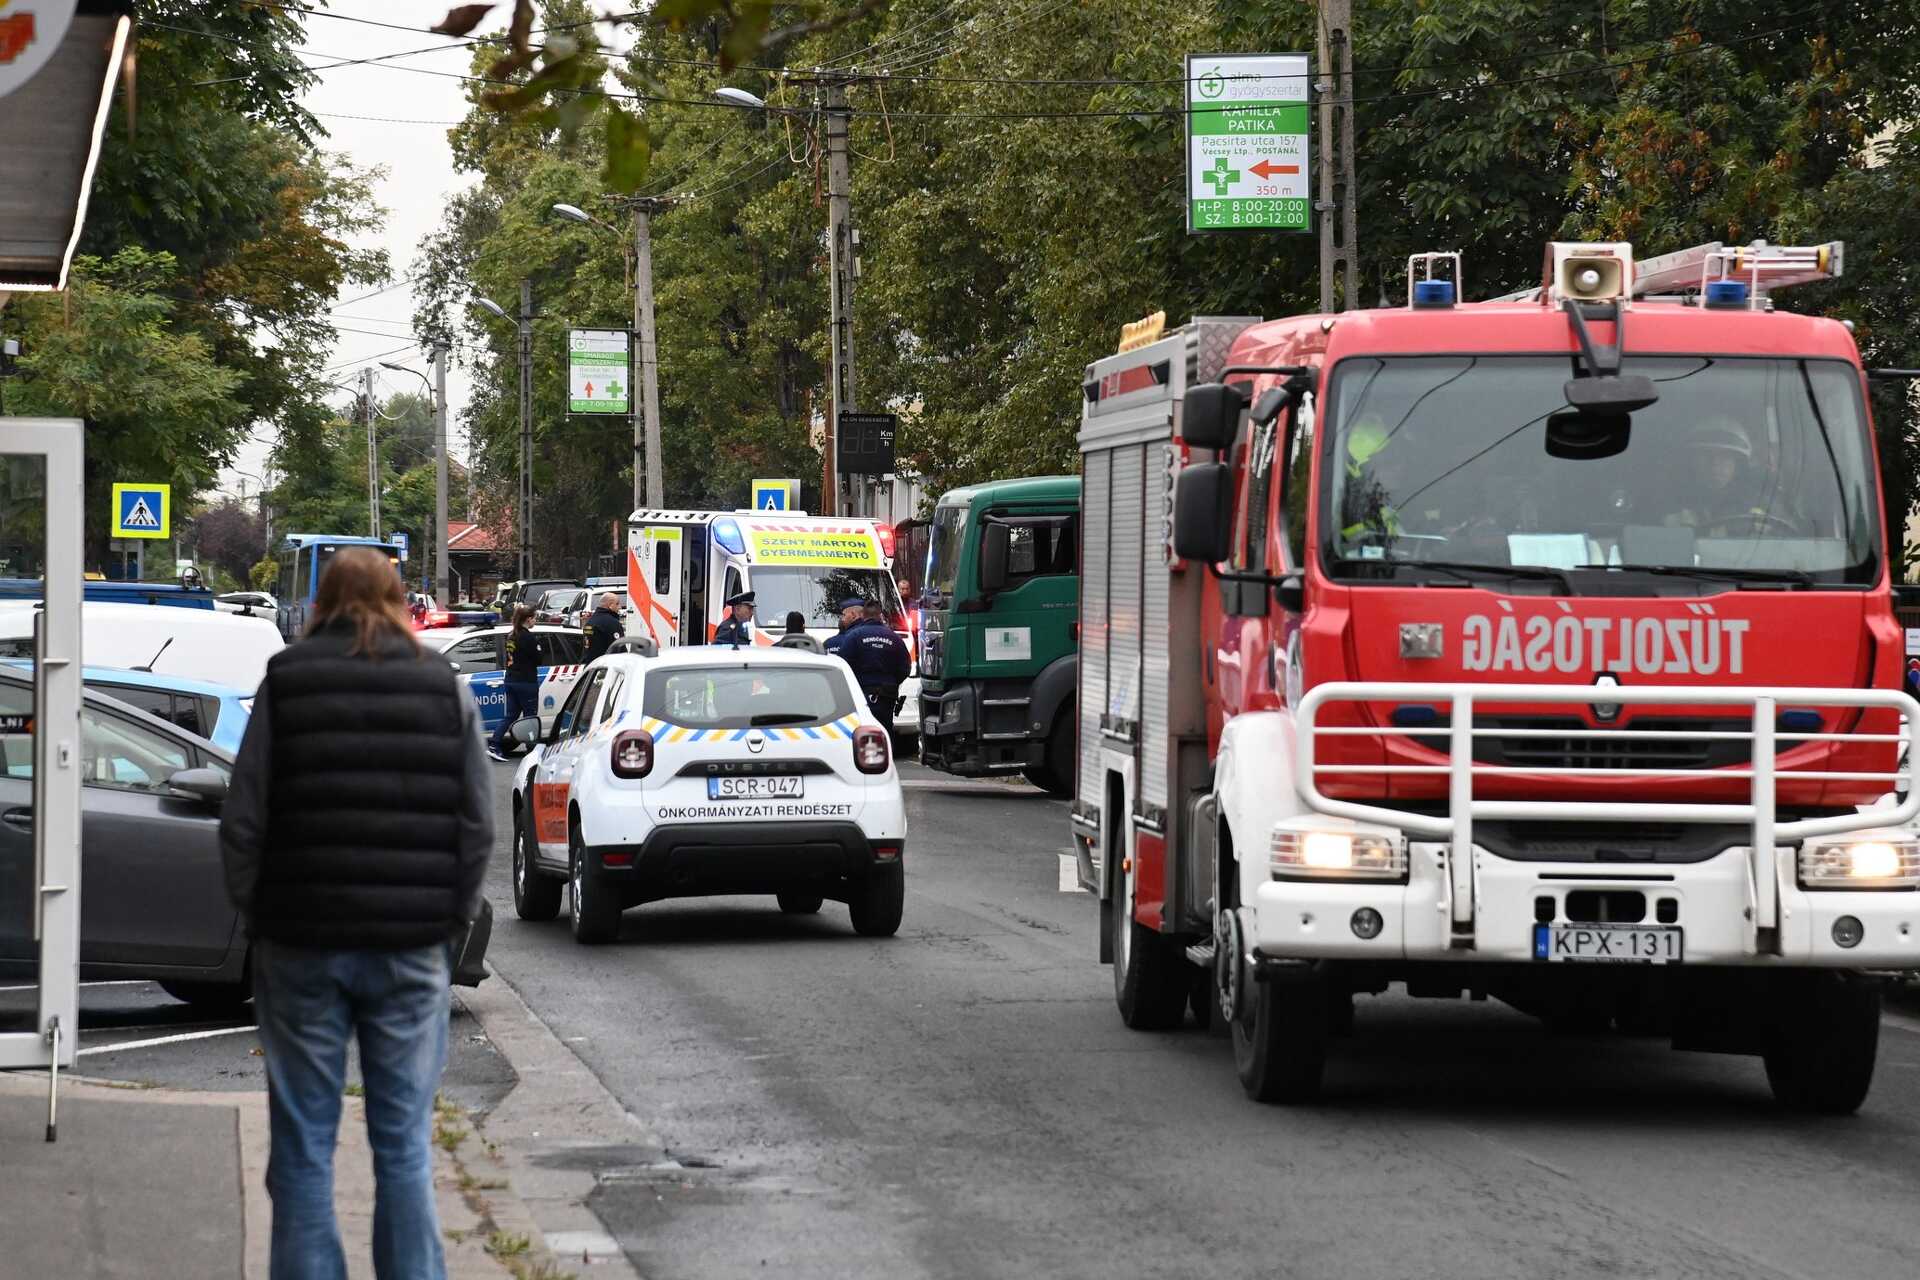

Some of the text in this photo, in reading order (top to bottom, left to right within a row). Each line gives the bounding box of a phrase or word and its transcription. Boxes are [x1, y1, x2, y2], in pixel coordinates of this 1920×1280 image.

[1222, 105, 1281, 117] KAMILLA
[1228, 120, 1276, 131] PATIKA
[1202, 136, 1247, 146] Pacsirta
[1252, 136, 1275, 146] utca
[1256, 185, 1292, 195] 350 m
[1197, 201, 1304, 212] H-P: 8:00-20:00
[1204, 213, 1304, 224] SZ: 8:00-12:00
[762, 538, 805, 546] SZENT
[0, 717, 23, 728] LNI
[722, 777, 799, 794] SCR-047
[658, 803, 852, 819] ÖNKORMÁNYZATI RENDÉSZET
[1554, 930, 1673, 956] KPX-131
